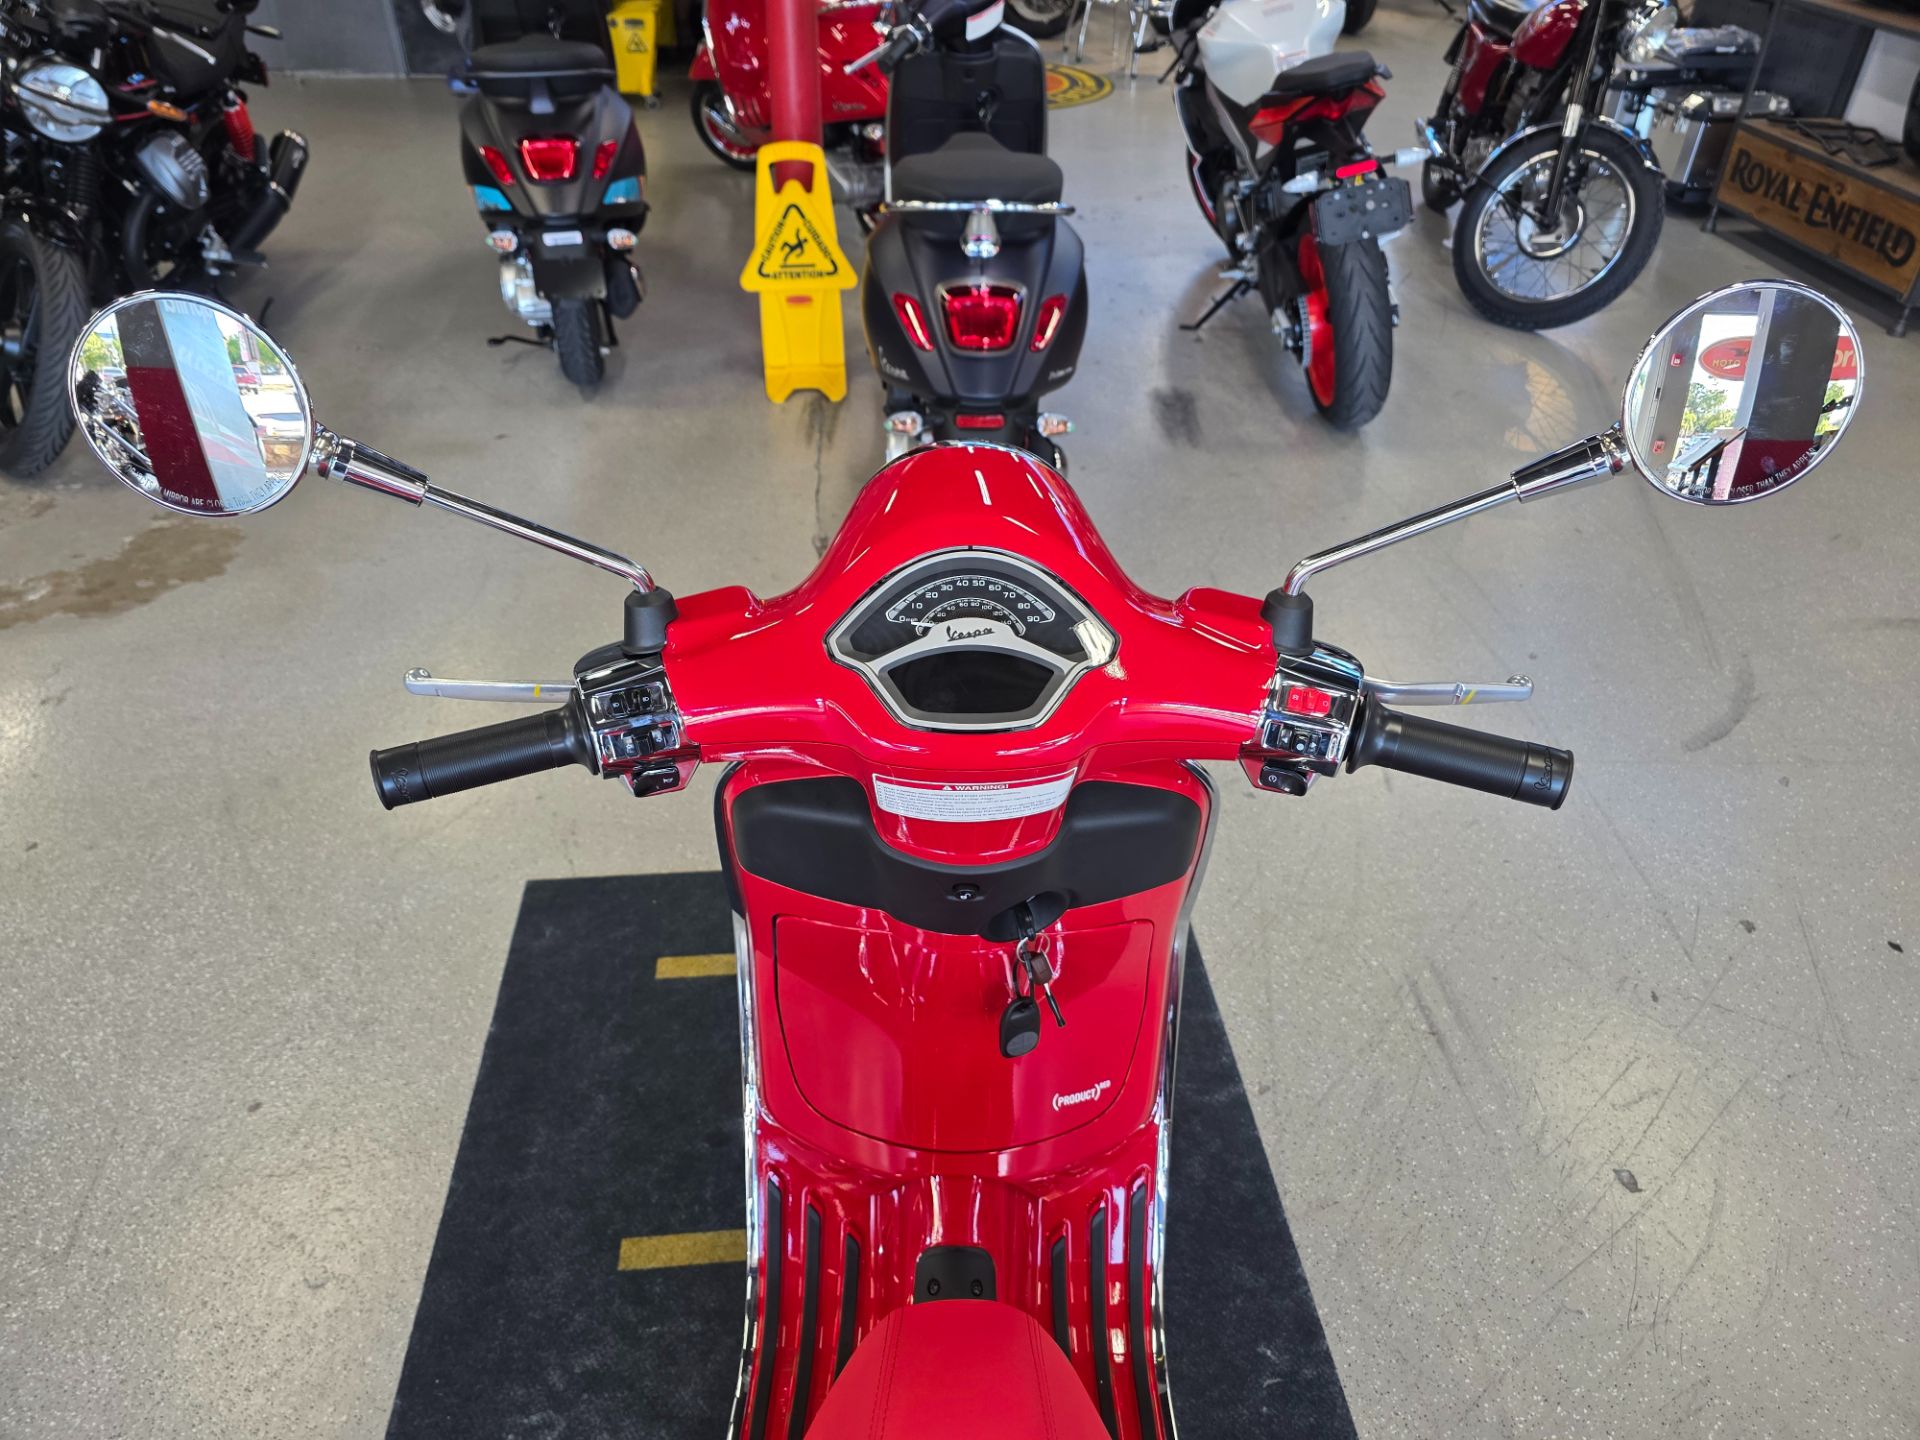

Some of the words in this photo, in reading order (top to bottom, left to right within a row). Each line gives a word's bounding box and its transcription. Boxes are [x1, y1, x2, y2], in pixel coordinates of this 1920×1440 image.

[1730, 148, 1802, 213] ROYAL
[1804, 183, 1916, 268] ENFIELD
[761, 219, 785, 262] CAUTION
[770, 271, 824, 280] ATTENTION
[1712, 358, 1741, 368] MOTO
[1756, 476, 1775, 491] THAN
[1775, 466, 1792, 482] THEY
[163, 488, 189, 504] MIRROR
[191, 497, 204, 506] ARE
[946, 624, 995, 642] Vespa
[954, 783, 1009, 791] WARNING!
[1052, 1083, 1101, 1112] (PRODUCT)
